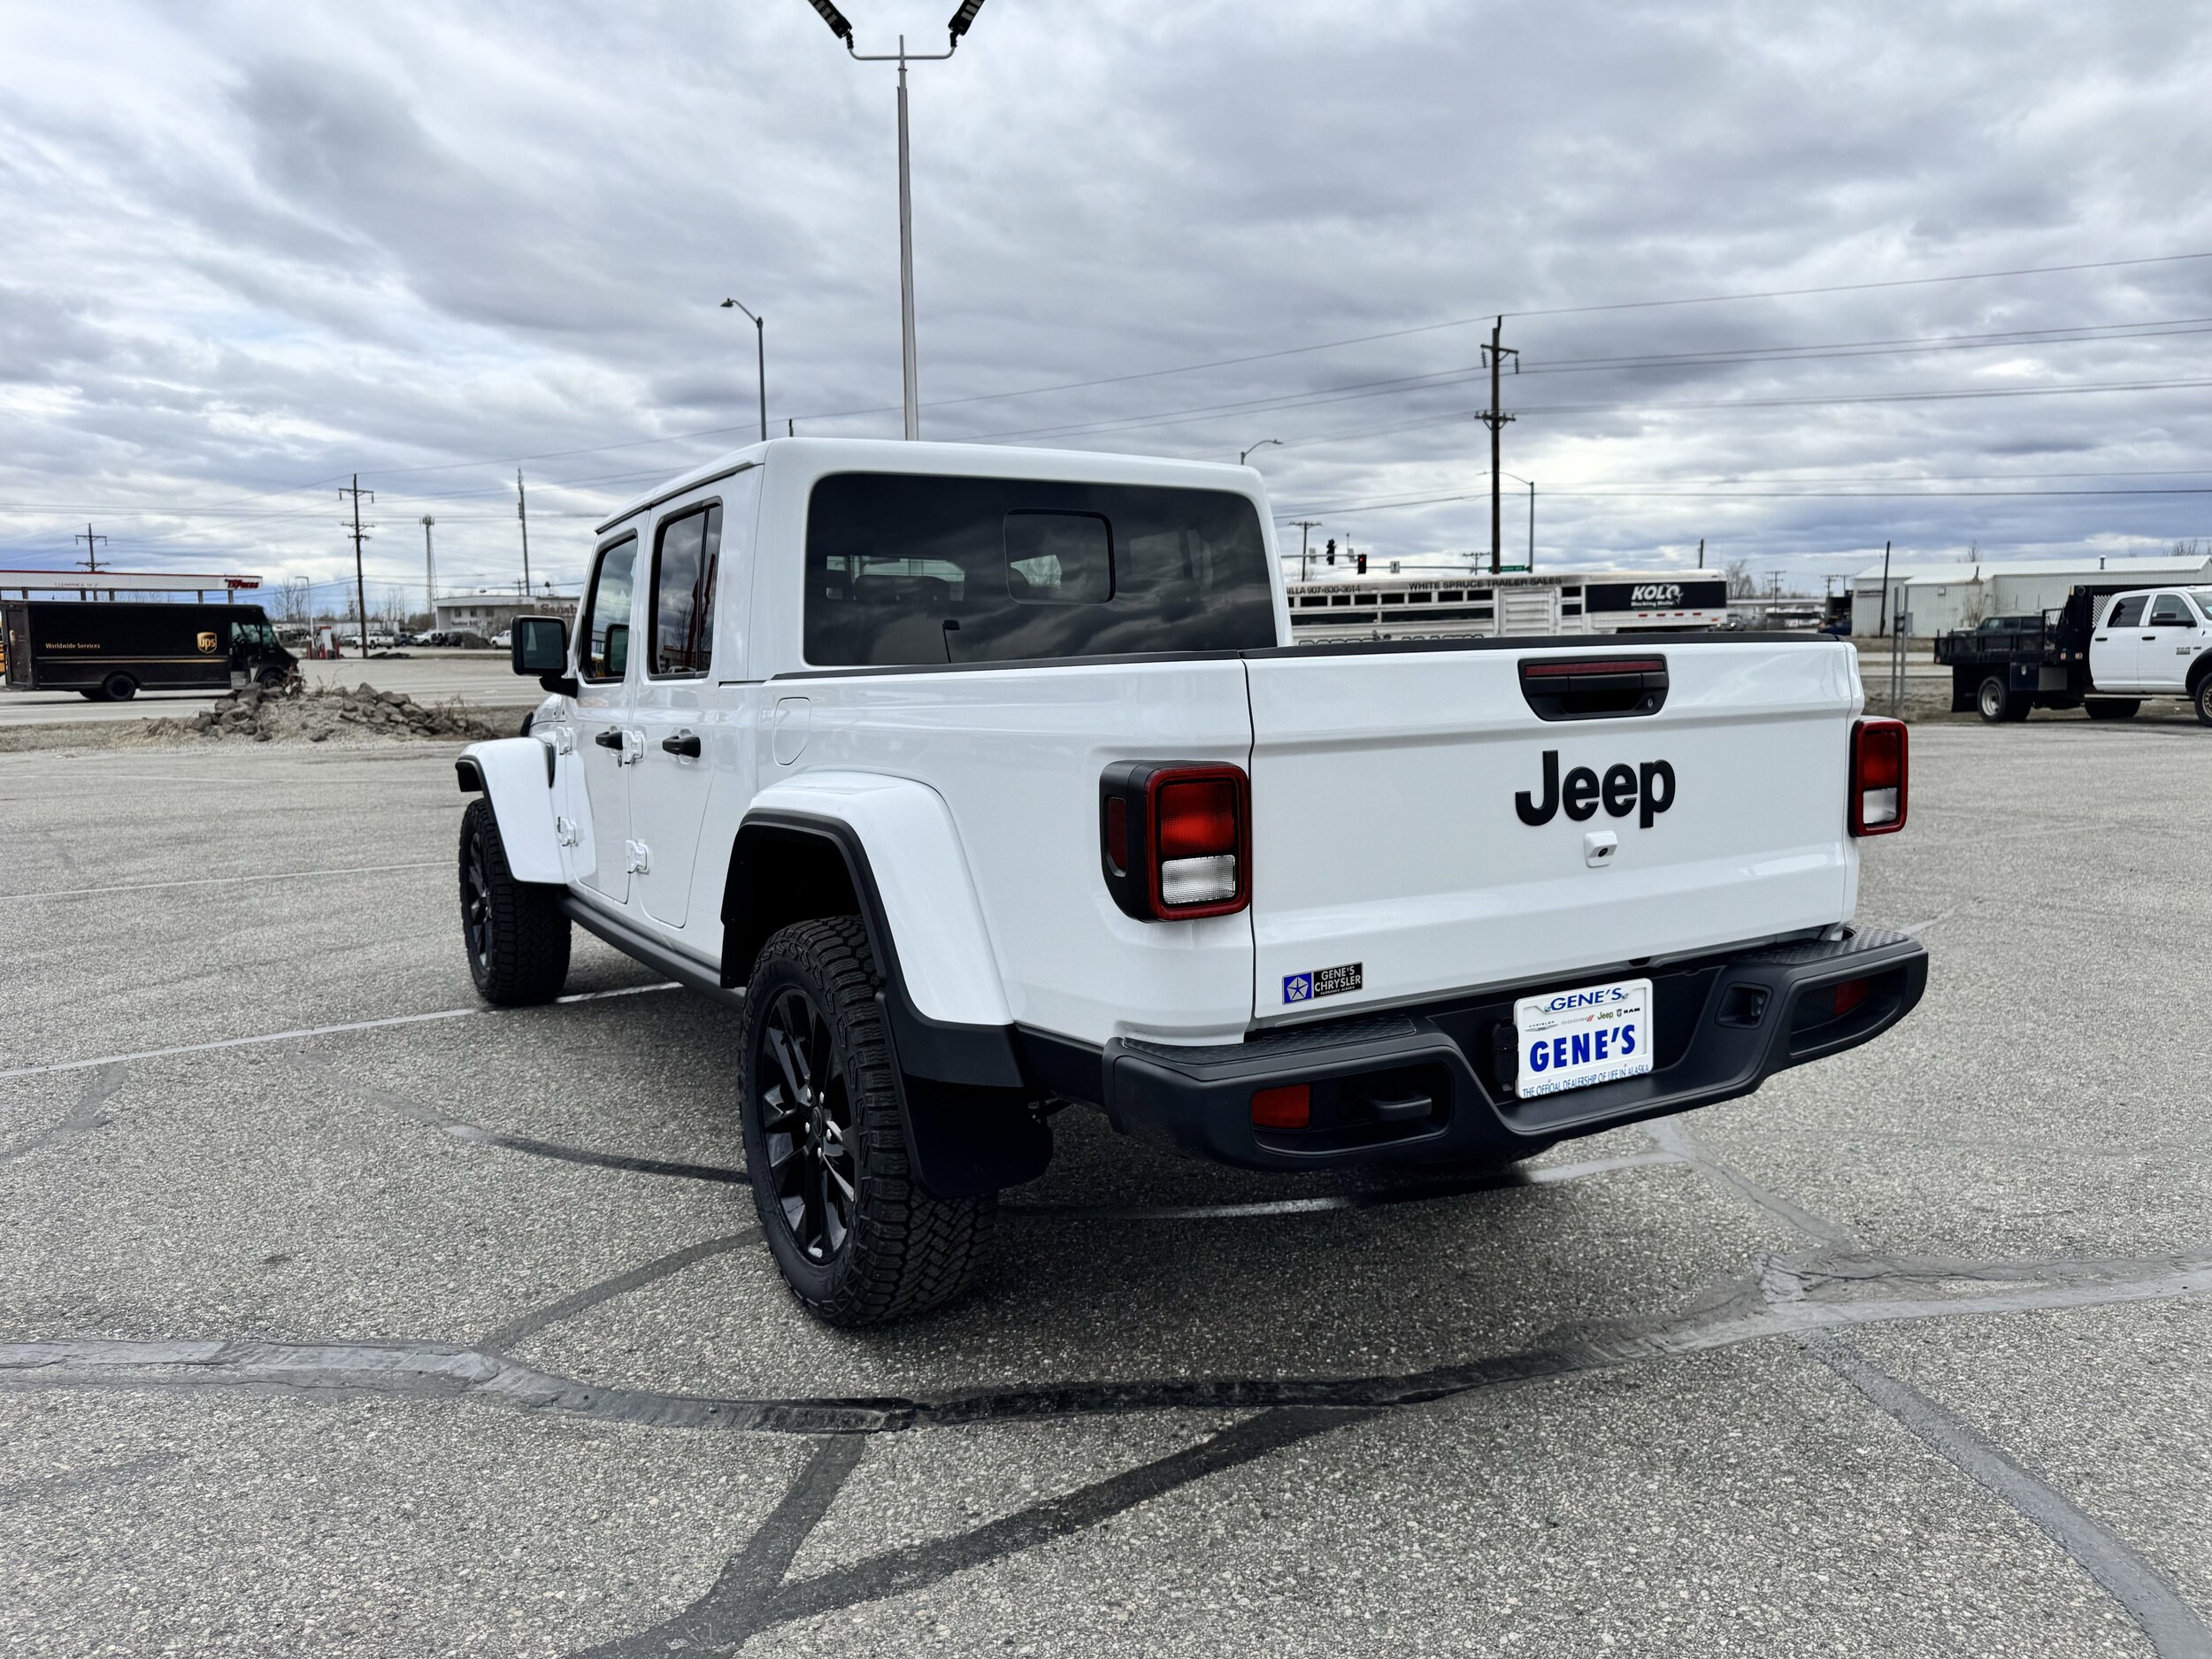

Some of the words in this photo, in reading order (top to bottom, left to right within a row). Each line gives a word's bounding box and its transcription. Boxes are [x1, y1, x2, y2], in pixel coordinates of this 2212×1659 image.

[1408, 580, 1440, 592] WHITE
[1442, 579, 1482, 590] SPRUCE
[1486, 577, 1528, 588] TRAILER
[1530, 576, 1563, 587] SALES
[1515, 749, 1676, 829] Jeep
[1314, 974, 1362, 992] CHRYSLER
[1321, 965, 1355, 980] GENE'S
[1550, 987, 1623, 1011] GENE'S
[1597, 1011, 1614, 1020] Jeep
[1529, 1024, 1636, 1072] GENE'S
[1523, 1087, 1535, 1098] THE
[1536, 1080, 1561, 1095] OFFICIAL
[1563, 1074, 1597, 1090] DEALERSHIP
[1597, 1071, 1608, 1083] OF
[1608, 1069, 1619, 1080] LIFE
[1619, 1068, 1626, 1078] IN
[1628, 1064, 1649, 1076] ALASKA
